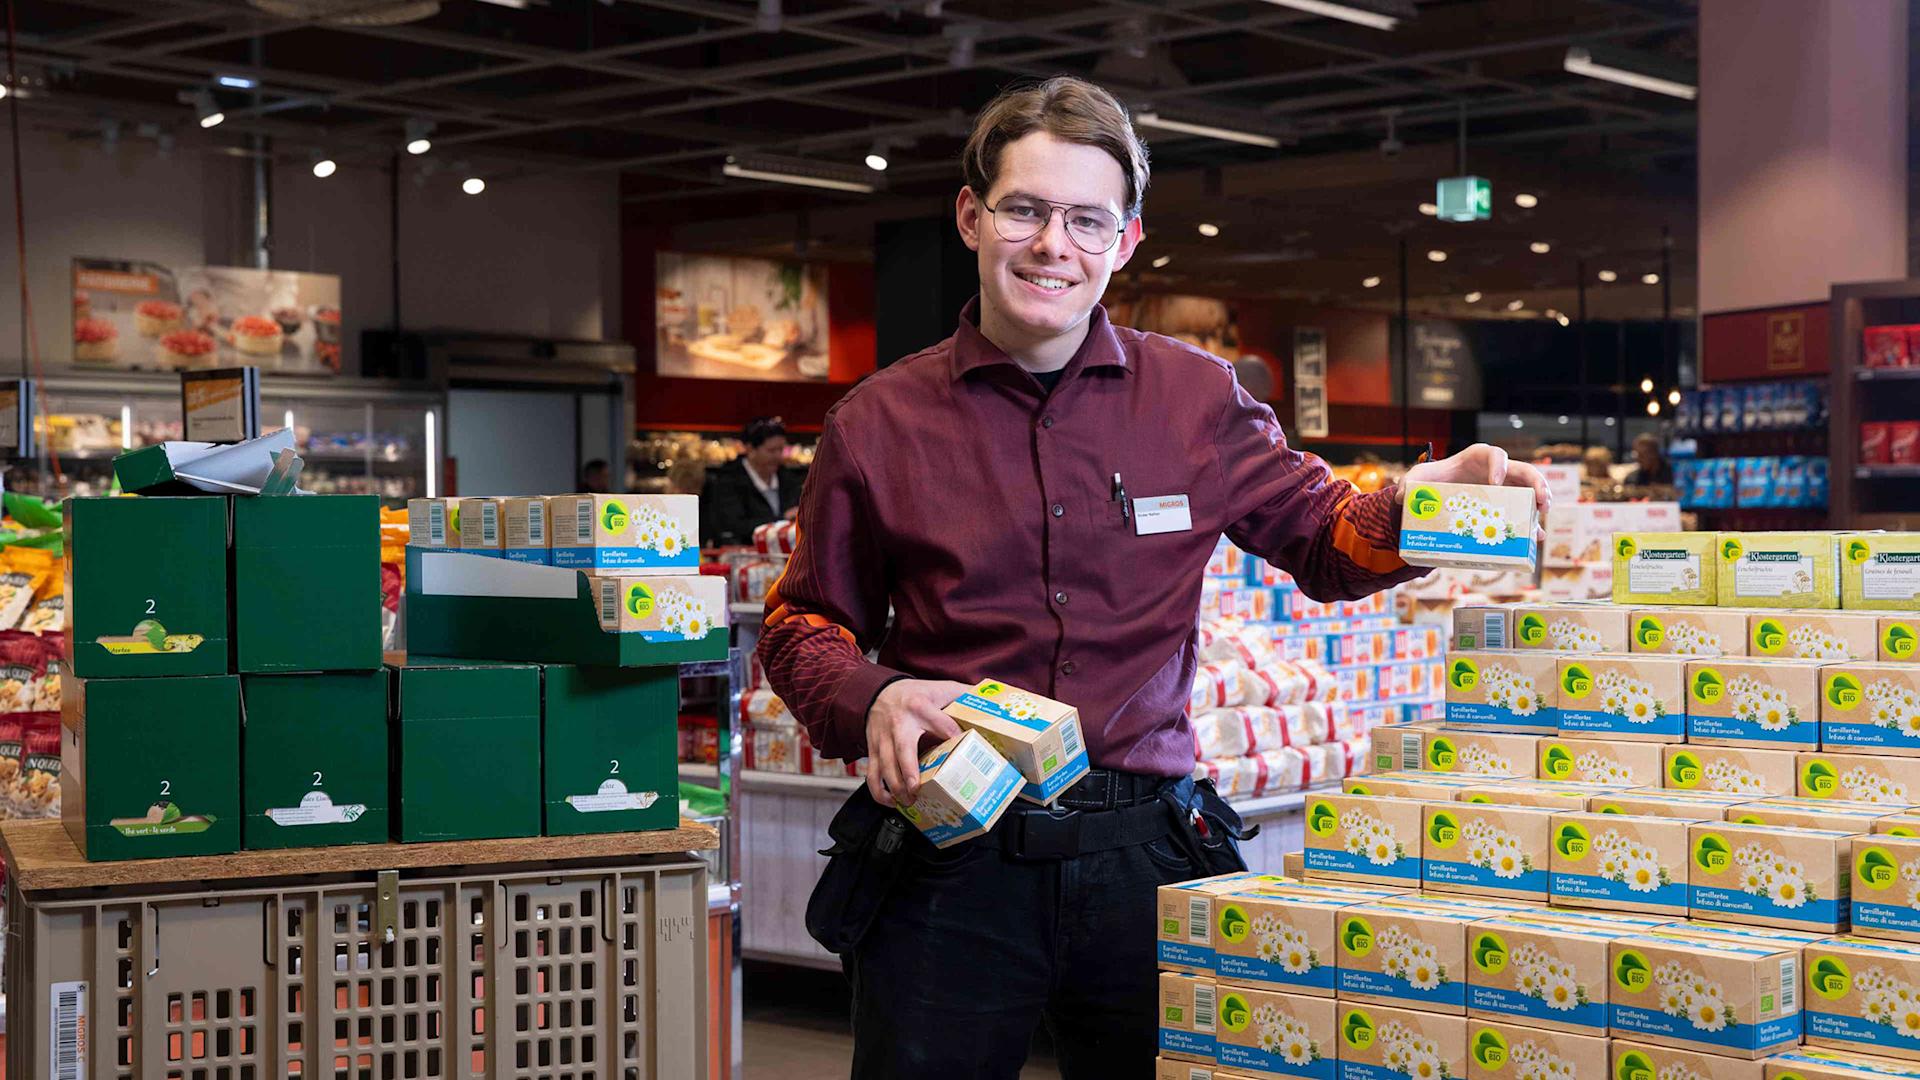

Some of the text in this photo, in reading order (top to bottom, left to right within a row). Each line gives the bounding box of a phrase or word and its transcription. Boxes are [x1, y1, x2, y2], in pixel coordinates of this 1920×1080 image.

[1159, 500, 1184, 509] MIGROS
[1642, 550, 1687, 560] Klostergarten
[1750, 552, 1798, 562] Klostergarten
[145, 599, 156, 614] 2
[1769, 638, 1781, 646] BIO
[1899, 643, 1911, 651] BIO
[1706, 688, 1719, 697] BIO
[1842, 694, 1856, 702] BIO
[1451, 706, 1478, 714] Kamillentee
[1451, 713, 1466, 721] Infuso
[1563, 713, 1592, 721] Kamillentee
[1563, 720, 1579, 728] Infuso
[1693, 719, 1723, 727] Kamillentee
[1693, 726, 1710, 734] Infuso
[1716, 728, 1744, 736] camomilla
[1828, 725, 1861, 735] Kamillentee
[1828, 733, 1846, 742] Infuso
[1853, 735, 1884, 743] camomilla
[610, 759, 620, 774] 2
[1557, 764, 1569, 772] BIO
[312, 771, 323, 786] 2
[160, 780, 170, 795] 2
[1571, 845, 1584, 853] BIO
[1309, 851, 1336, 860] Kamillentee
[1309, 858, 1324, 867] Infuso
[1711, 857, 1725, 865] BIO
[1429, 863, 1458, 873] Kamillentee
[1429, 871, 1445, 880] Infuso
[1876, 872, 1891, 881] BIO
[1556, 876, 1587, 886] Kamillentee
[1556, 884, 1573, 893] Infuso
[1581, 886, 1610, 896] camomilla
[1696, 889, 1729, 900] Kamillentee
[1696, 897, 1715, 906] Infuso
[1721, 900, 1753, 911] camomilla
[1859, 905, 1896, 917] Kamillentee
[1859, 913, 1880, 923] Infuso
[1356, 940, 1368, 949] BIO
[1488, 957, 1501, 965] BIO
[1343, 973, 1372, 983] Kamillentee
[1631, 974, 1645, 983] BIO
[1343, 979, 1360, 989] Infuso
[1828, 982, 1843, 990] BIO
[1474, 989, 1506, 1001] Kamillentee
[1474, 997, 1492, 1007] Infuso
[1616, 1009, 1650, 1021] Kamillentee
[1616, 1017, 1635, 1027] Infuso
[1642, 1020, 1673, 1032] camomilla
[1812, 1016, 1849, 1028] Kamillentee
[77, 1015, 86, 1053] MIGROS
[1812, 1024, 1833, 1034] Infuso
[1841, 1028, 1876, 1040] camomilla
[1488, 1053, 1501, 1062] BIO
